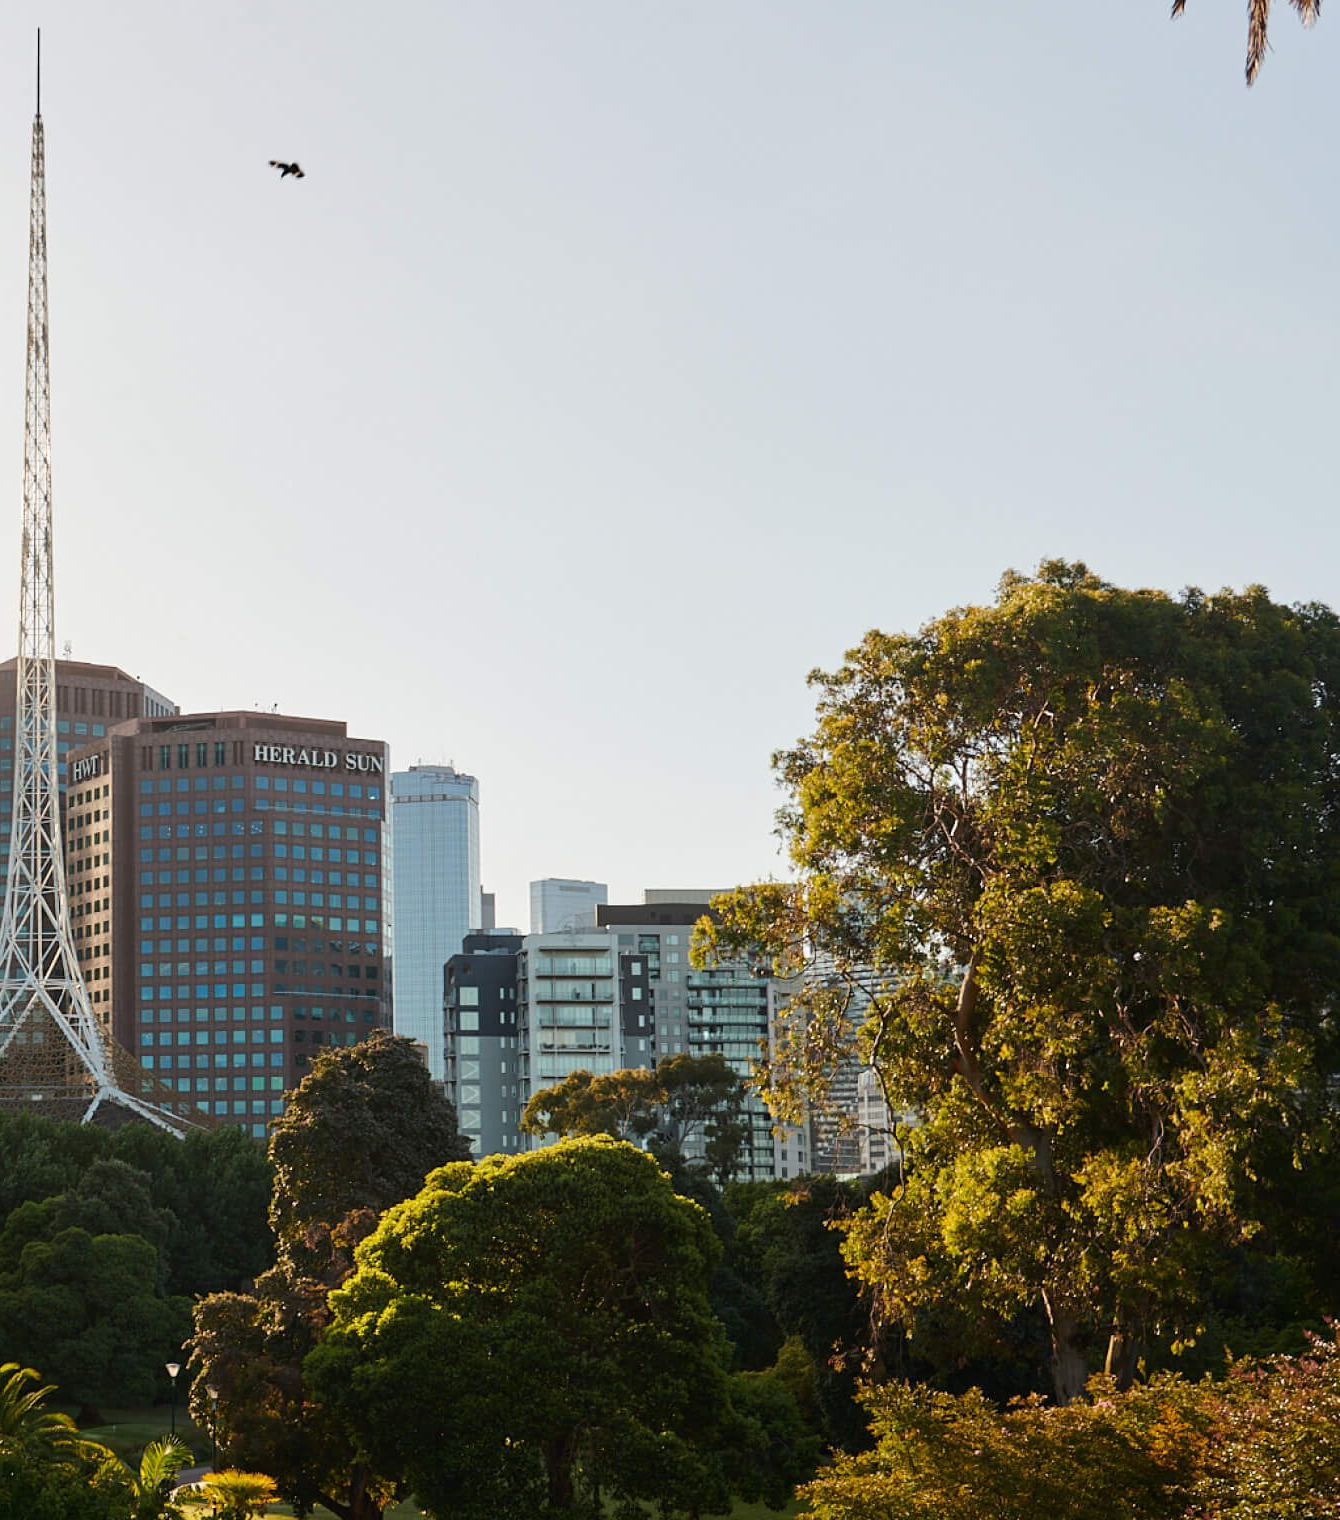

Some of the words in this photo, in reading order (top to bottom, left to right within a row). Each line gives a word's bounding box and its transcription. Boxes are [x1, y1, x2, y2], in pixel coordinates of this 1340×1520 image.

[73, 754, 99, 781] HWT
[254, 744, 339, 768] HERALD
[345, 754, 384, 773] SUN
